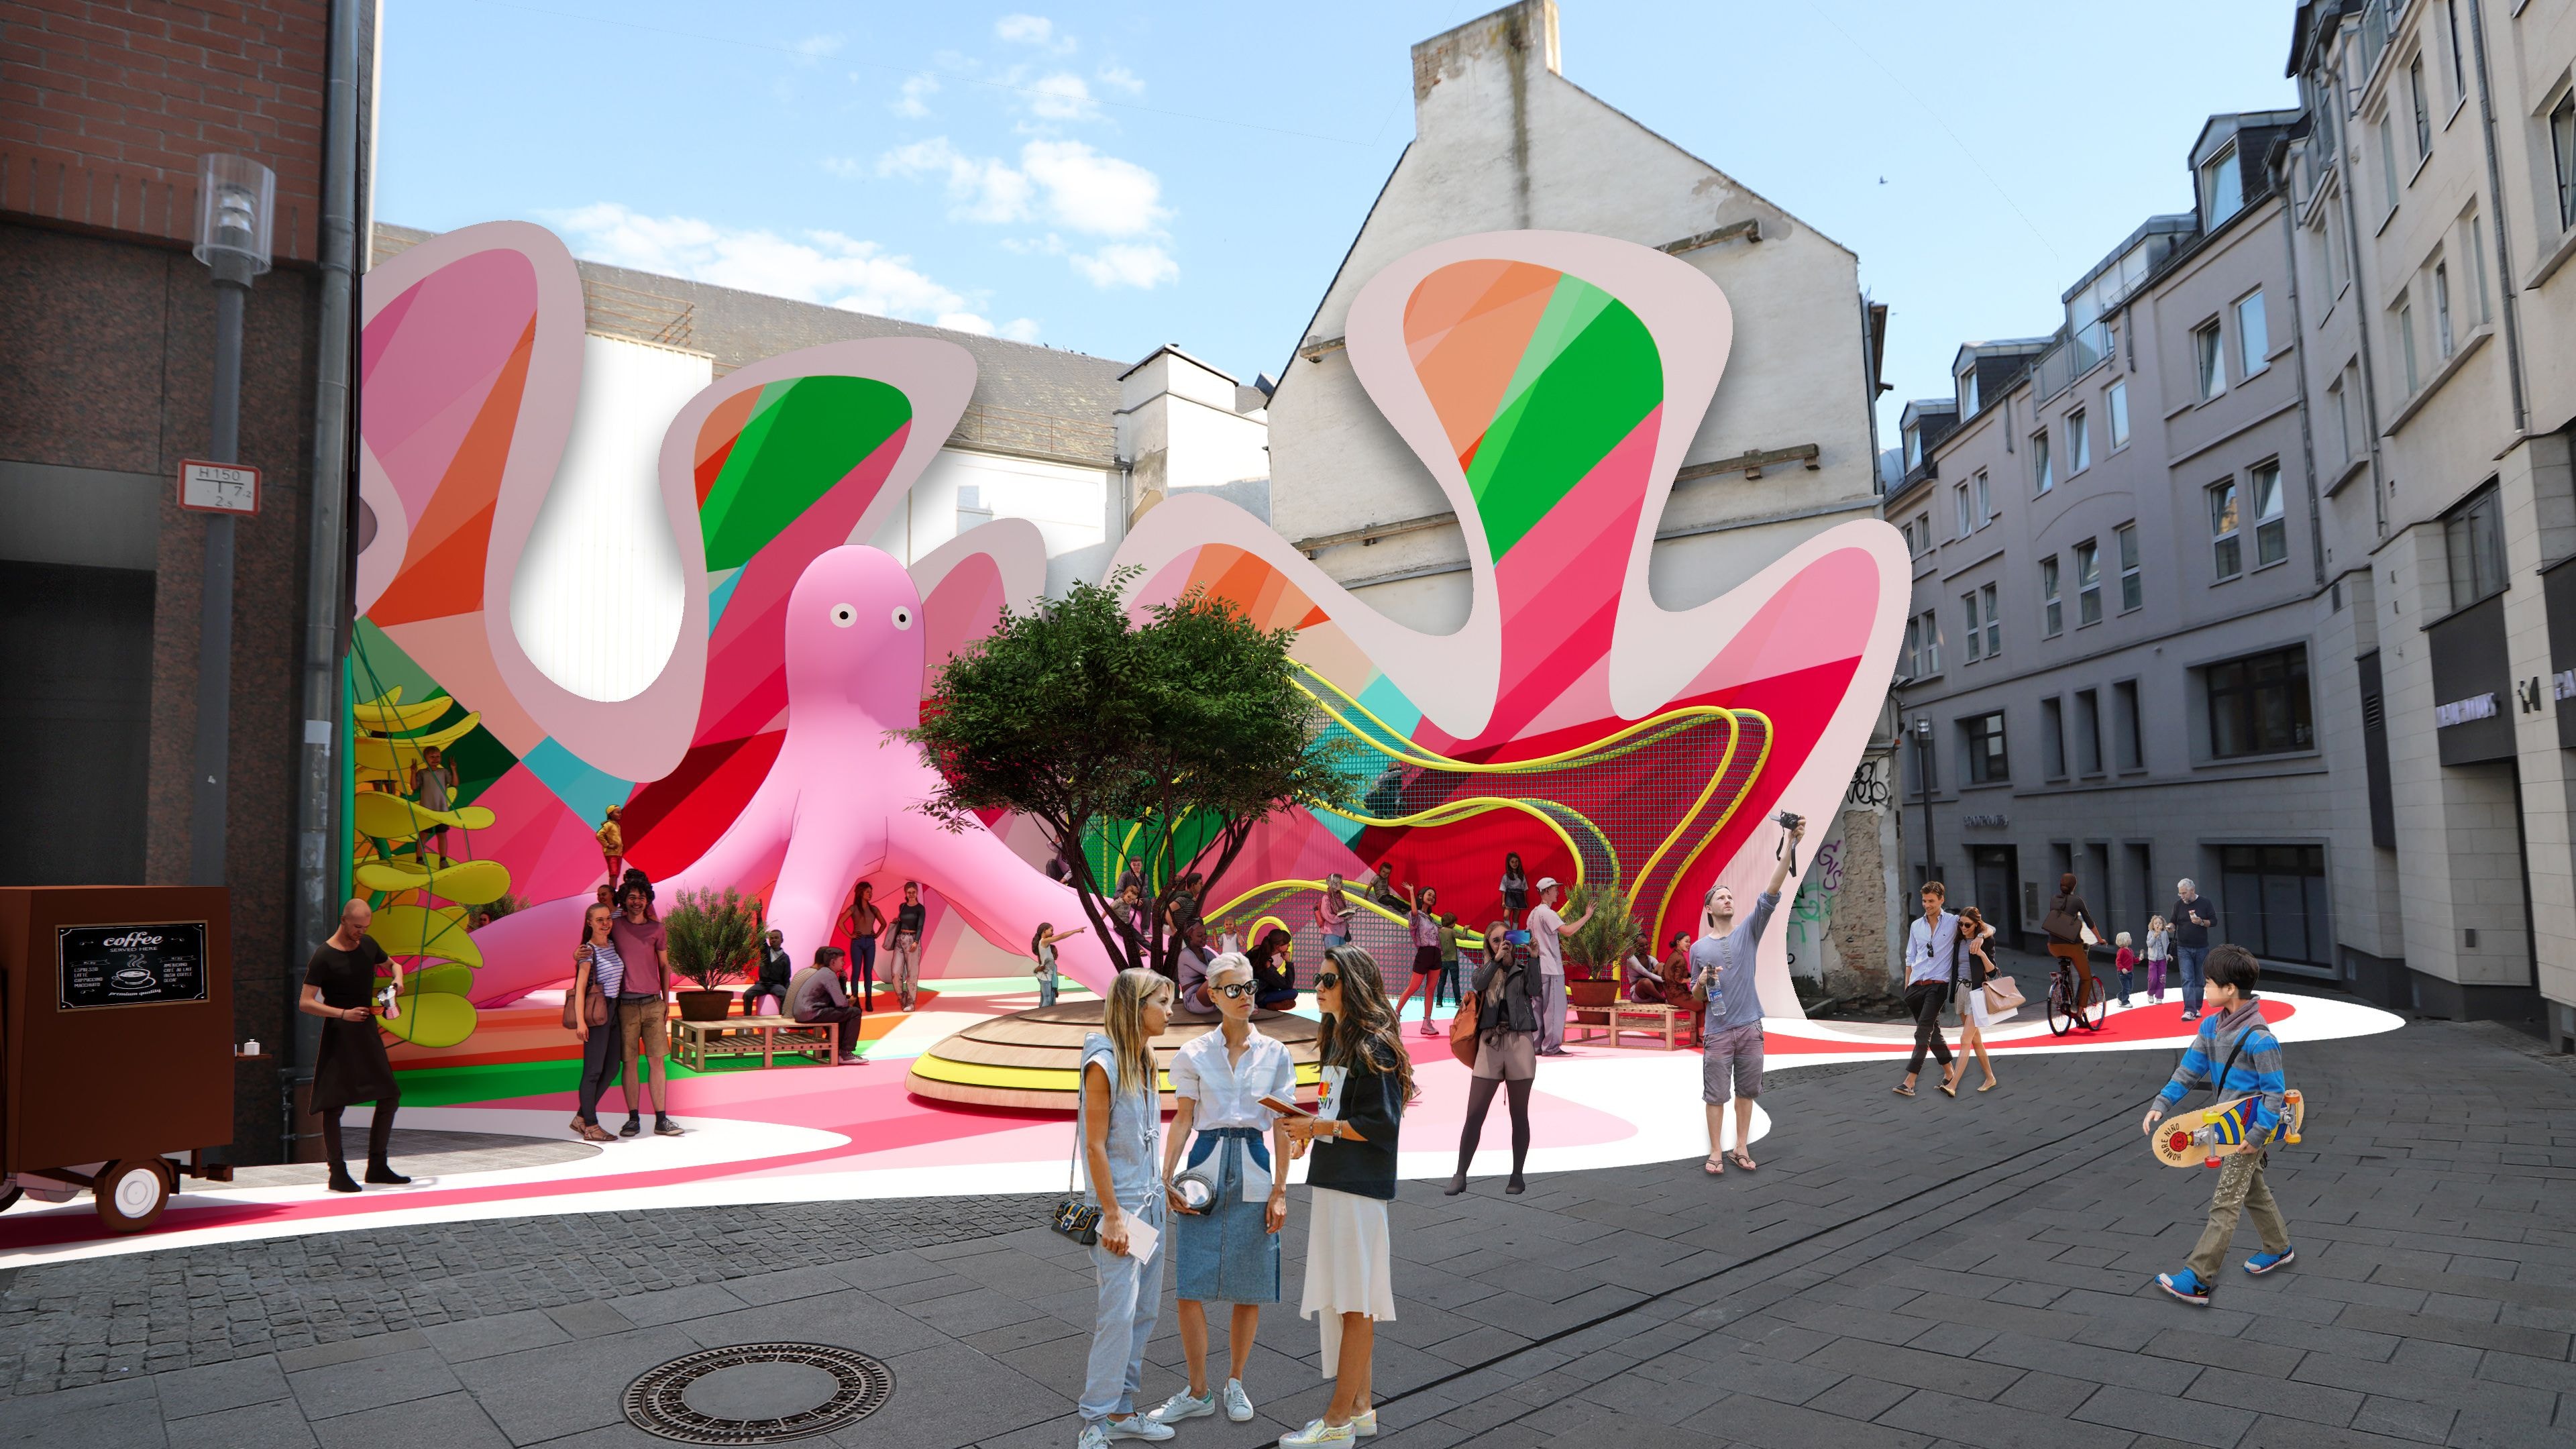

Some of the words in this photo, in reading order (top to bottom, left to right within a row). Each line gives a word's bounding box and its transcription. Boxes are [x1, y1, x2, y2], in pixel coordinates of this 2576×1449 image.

[103, 931, 164, 947] coffee
[138, 988, 162, 996] quality
[2163, 1122, 2180, 1137] NIÑO
[2161, 1138, 2182, 1161] HOMBRE
